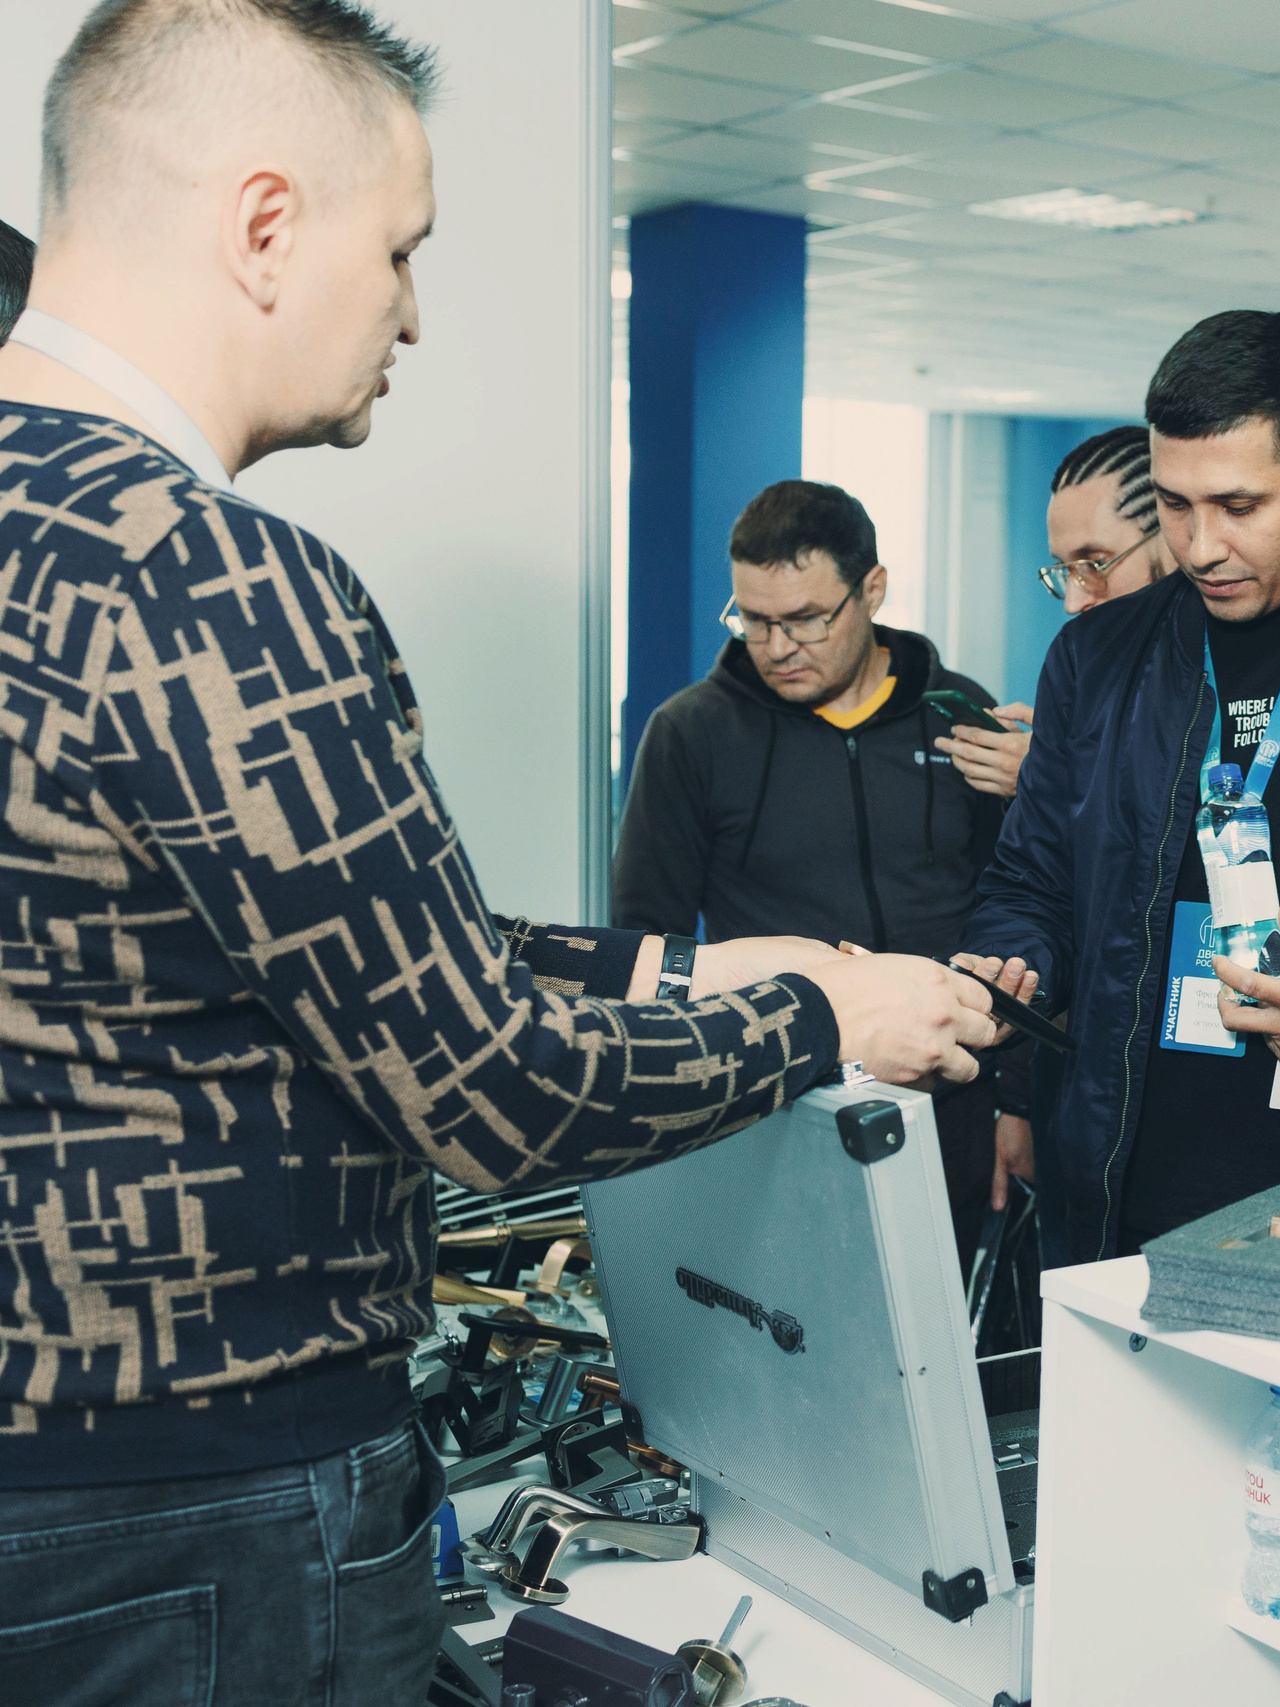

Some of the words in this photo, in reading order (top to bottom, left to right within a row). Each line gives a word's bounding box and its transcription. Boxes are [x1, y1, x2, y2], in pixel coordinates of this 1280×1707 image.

[1228, 698, 1268, 716] WHERE
[1269, 696, 1274, 710] I
[1235, 712, 1270, 732] TROUB
[1234, 729, 1266, 748] FOLLO
[1195, 959, 1212, 968] РОС
[1196, 949, 1216, 959] ДВЕ
[1165, 976, 1181, 1041] УЧАСТНИК
[1197, 1000, 1217, 1009] Рома
